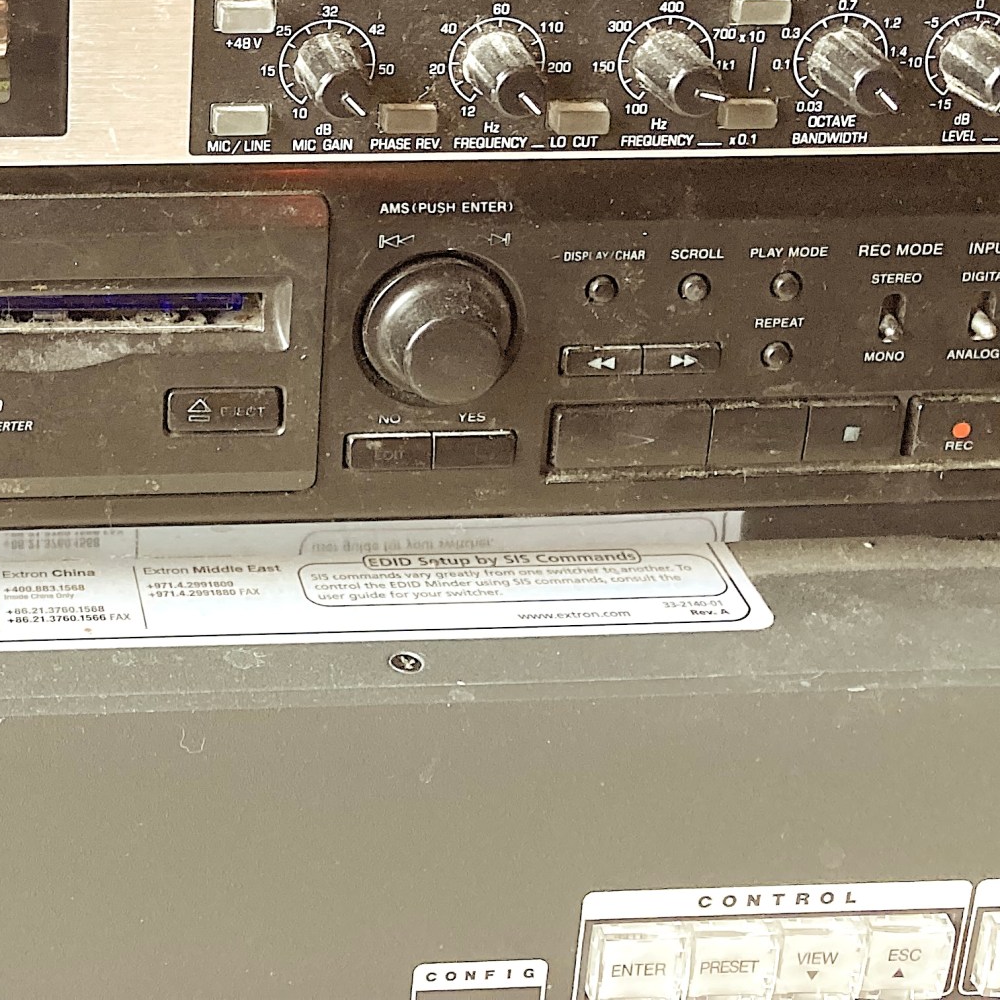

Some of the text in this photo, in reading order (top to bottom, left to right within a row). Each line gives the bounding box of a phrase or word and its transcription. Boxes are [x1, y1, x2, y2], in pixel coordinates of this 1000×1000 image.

[322, 6, 338, 18] 32
[492, 3, 510, 15] 60
[659, 1, 684, 13] 400
[650, 117, 668, 130] Hz
[807, 114, 857, 128] OCTAVE
[550, 135, 599, 148] LO CUT
[620, 134, 694, 146] FREQUENCY
[792, 130, 868, 144] BANDWIDTH
[942, 130, 976, 142] LEVEL
[292, 139, 353, 151] MIC GAIN
[370, 138, 442, 151] PHASE REV.
[453, 136, 528, 149] FREQUENCY
[462, 202, 513, 212] ENTER)
[670, 249, 724, 260] SCROLL
[750, 247, 829, 258] PLAY MODE
[858, 243, 944, 257] REC MODE
[871, 273, 922, 284] STEREO
[754, 317, 805, 329] REPEAT
[863, 351, 904, 362] MONO
[947, 349, 1000, 360] ANALOG
[378, 414, 401, 424] NO
[459, 412, 486, 422] YES
[945, 441, 973, 451] REC
[368, 556, 411, 567] EDID
[475, 555, 498, 567] by
[504, 554, 530, 564] SIS
[536, 551, 636, 563] Commands
[2, 569, 95, 579] Extron China
[143, 563, 281, 575] Extron Middle East
[517, 610, 631, 619] www.extron.com
[698, 891, 857, 908] CONTROL
[797, 951, 839, 966] VIEW
[888, 948, 922, 963] ESC
[611, 962, 666, 977] ENTER
[700, 960, 759, 975] PRESET
[425, 968, 536, 983] CONFIG
